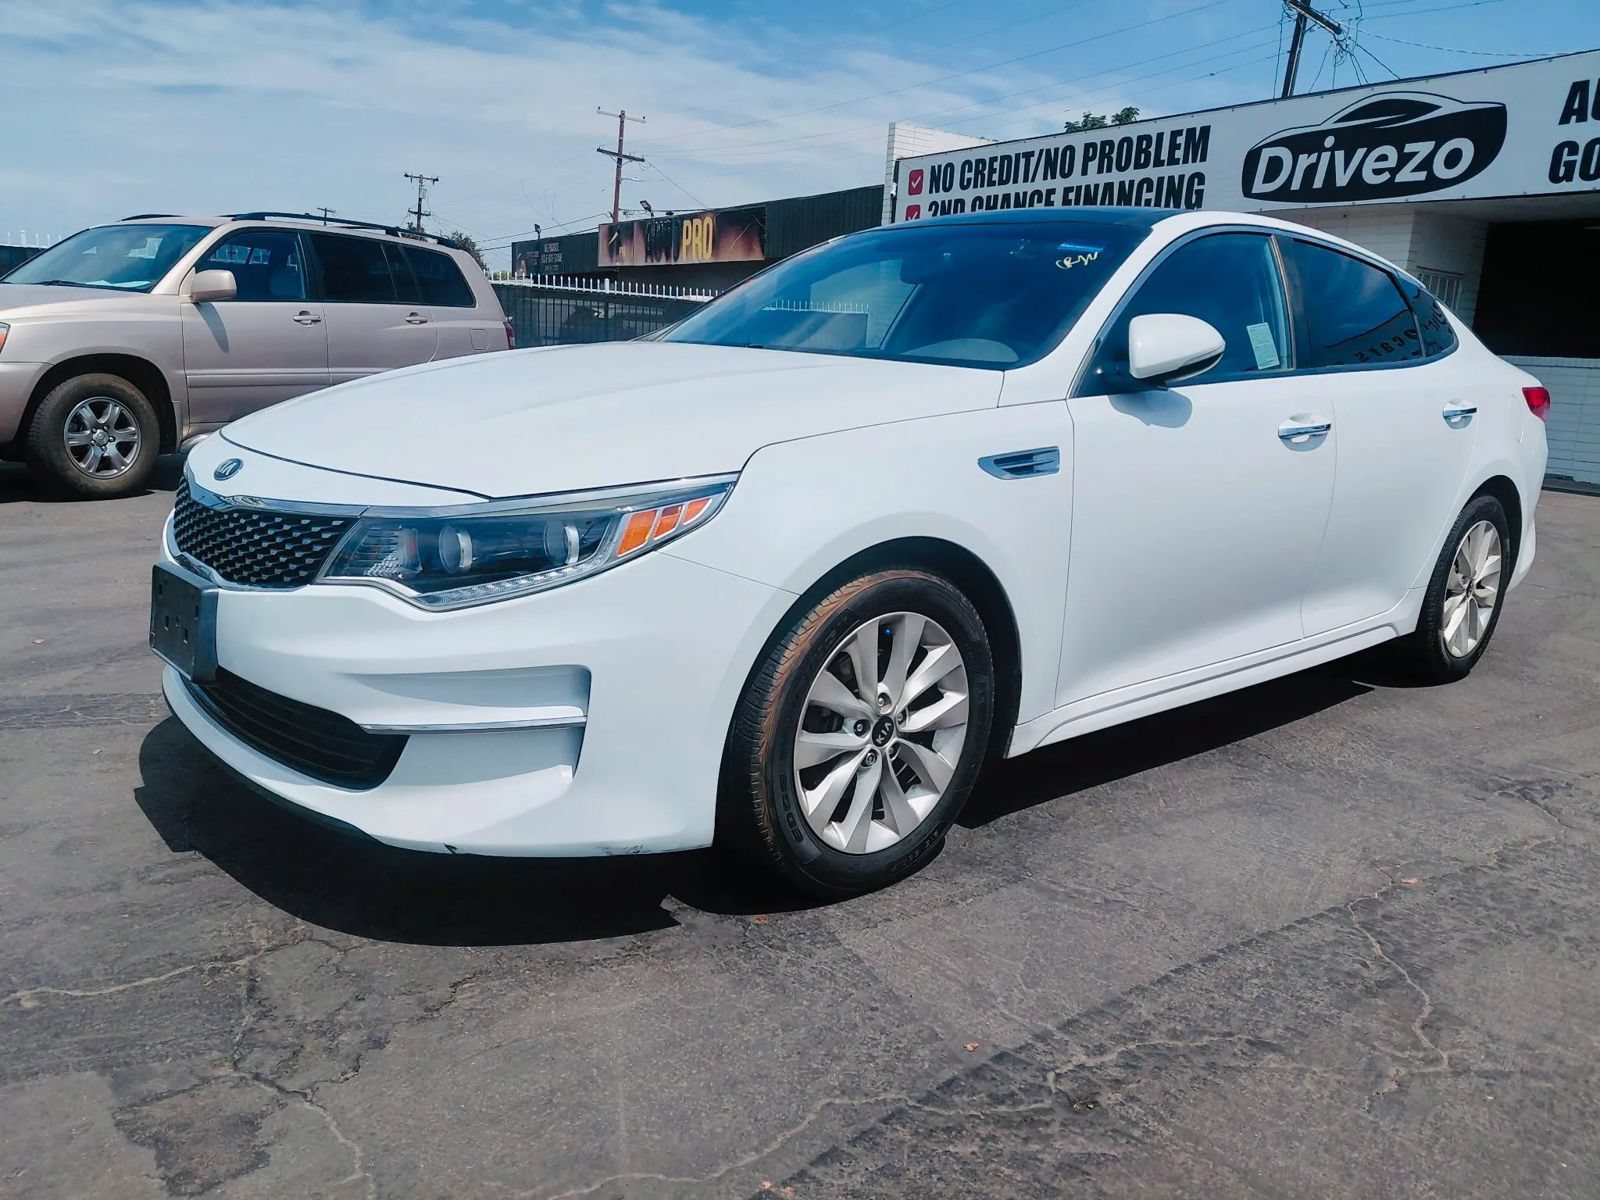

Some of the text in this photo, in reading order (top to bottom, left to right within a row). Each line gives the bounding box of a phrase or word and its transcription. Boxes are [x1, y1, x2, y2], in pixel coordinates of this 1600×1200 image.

[929, 125, 1212, 194] NO CREDIT/NO PROBLEM
[1251, 135, 1475, 194] Drivezo
[1062, 172, 1206, 210] FINANCING
[682, 216, 714, 262] PRO
[875, 722, 892, 745] KIA
